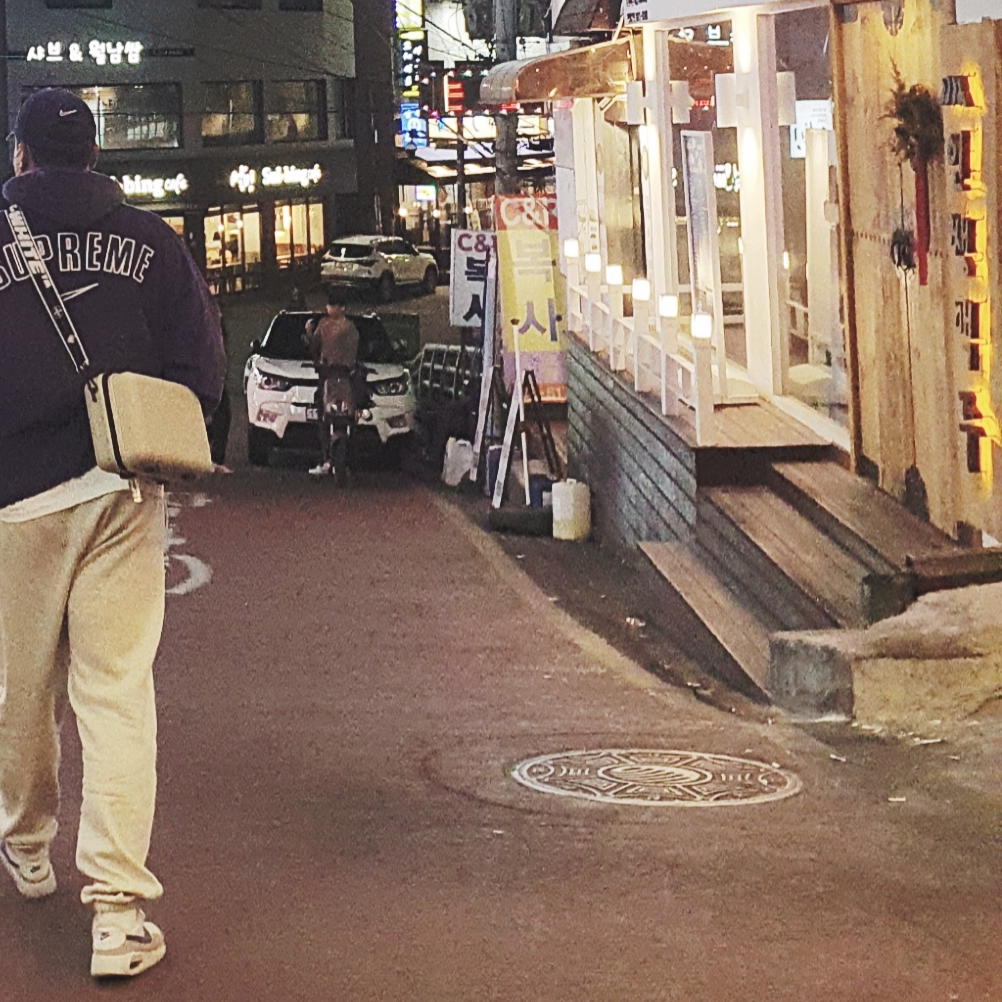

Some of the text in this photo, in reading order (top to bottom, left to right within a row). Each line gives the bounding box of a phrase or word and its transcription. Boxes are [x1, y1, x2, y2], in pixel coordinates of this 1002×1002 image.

[26, 41, 64, 63] 샤브
[68, 45, 84, 63] &
[88, 39, 144, 66] 월남쌈
